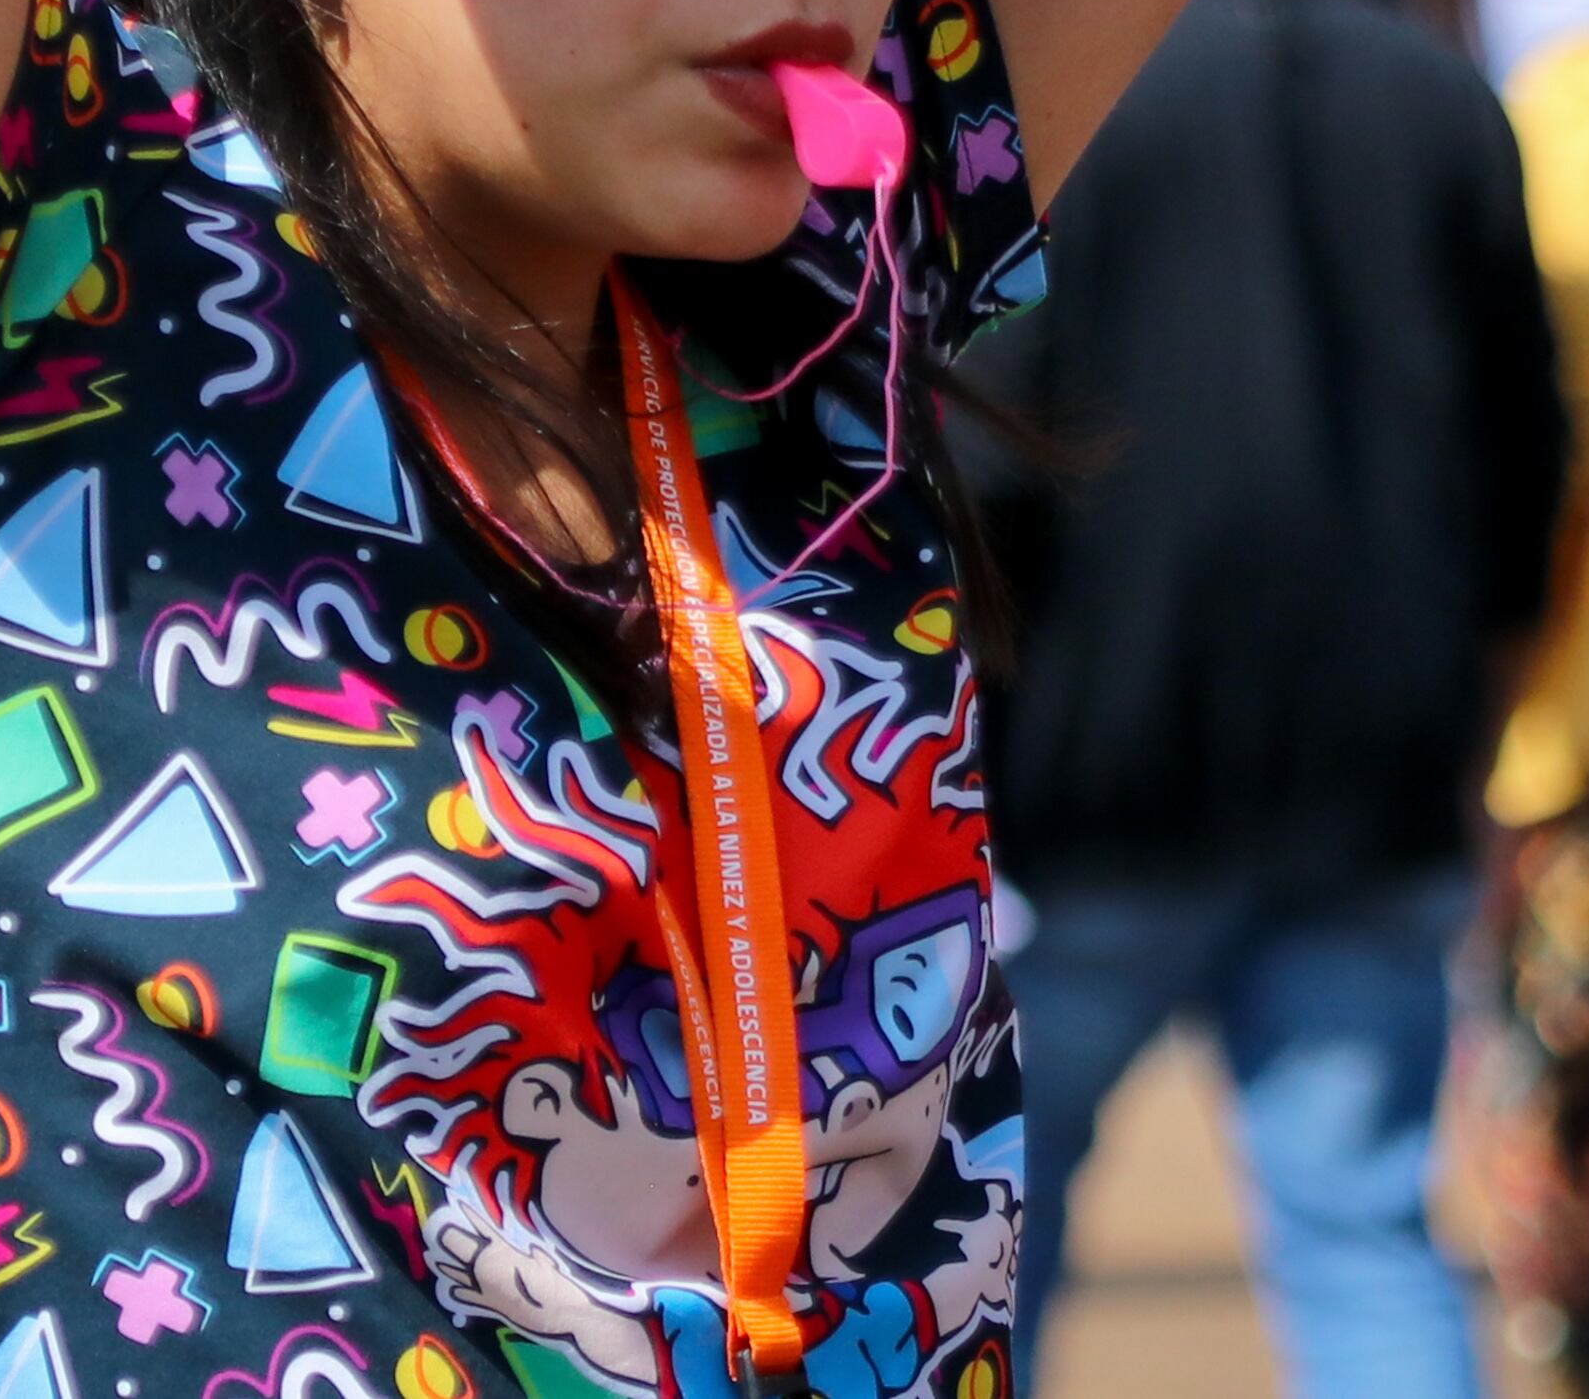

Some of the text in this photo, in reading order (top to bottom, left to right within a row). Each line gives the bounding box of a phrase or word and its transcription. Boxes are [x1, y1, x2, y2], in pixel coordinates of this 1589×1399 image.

[647, 420, 668, 452] DE
[684, 596, 730, 765] ESPECIALIZADA
[712, 773, 733, 790] A
[714, 797, 739, 828] LA
[726, 914, 749, 931] Y
[666, 929, 724, 1120] ADOLESCENCIA
[728, 936, 770, 1126] ADOLESCENCIA
